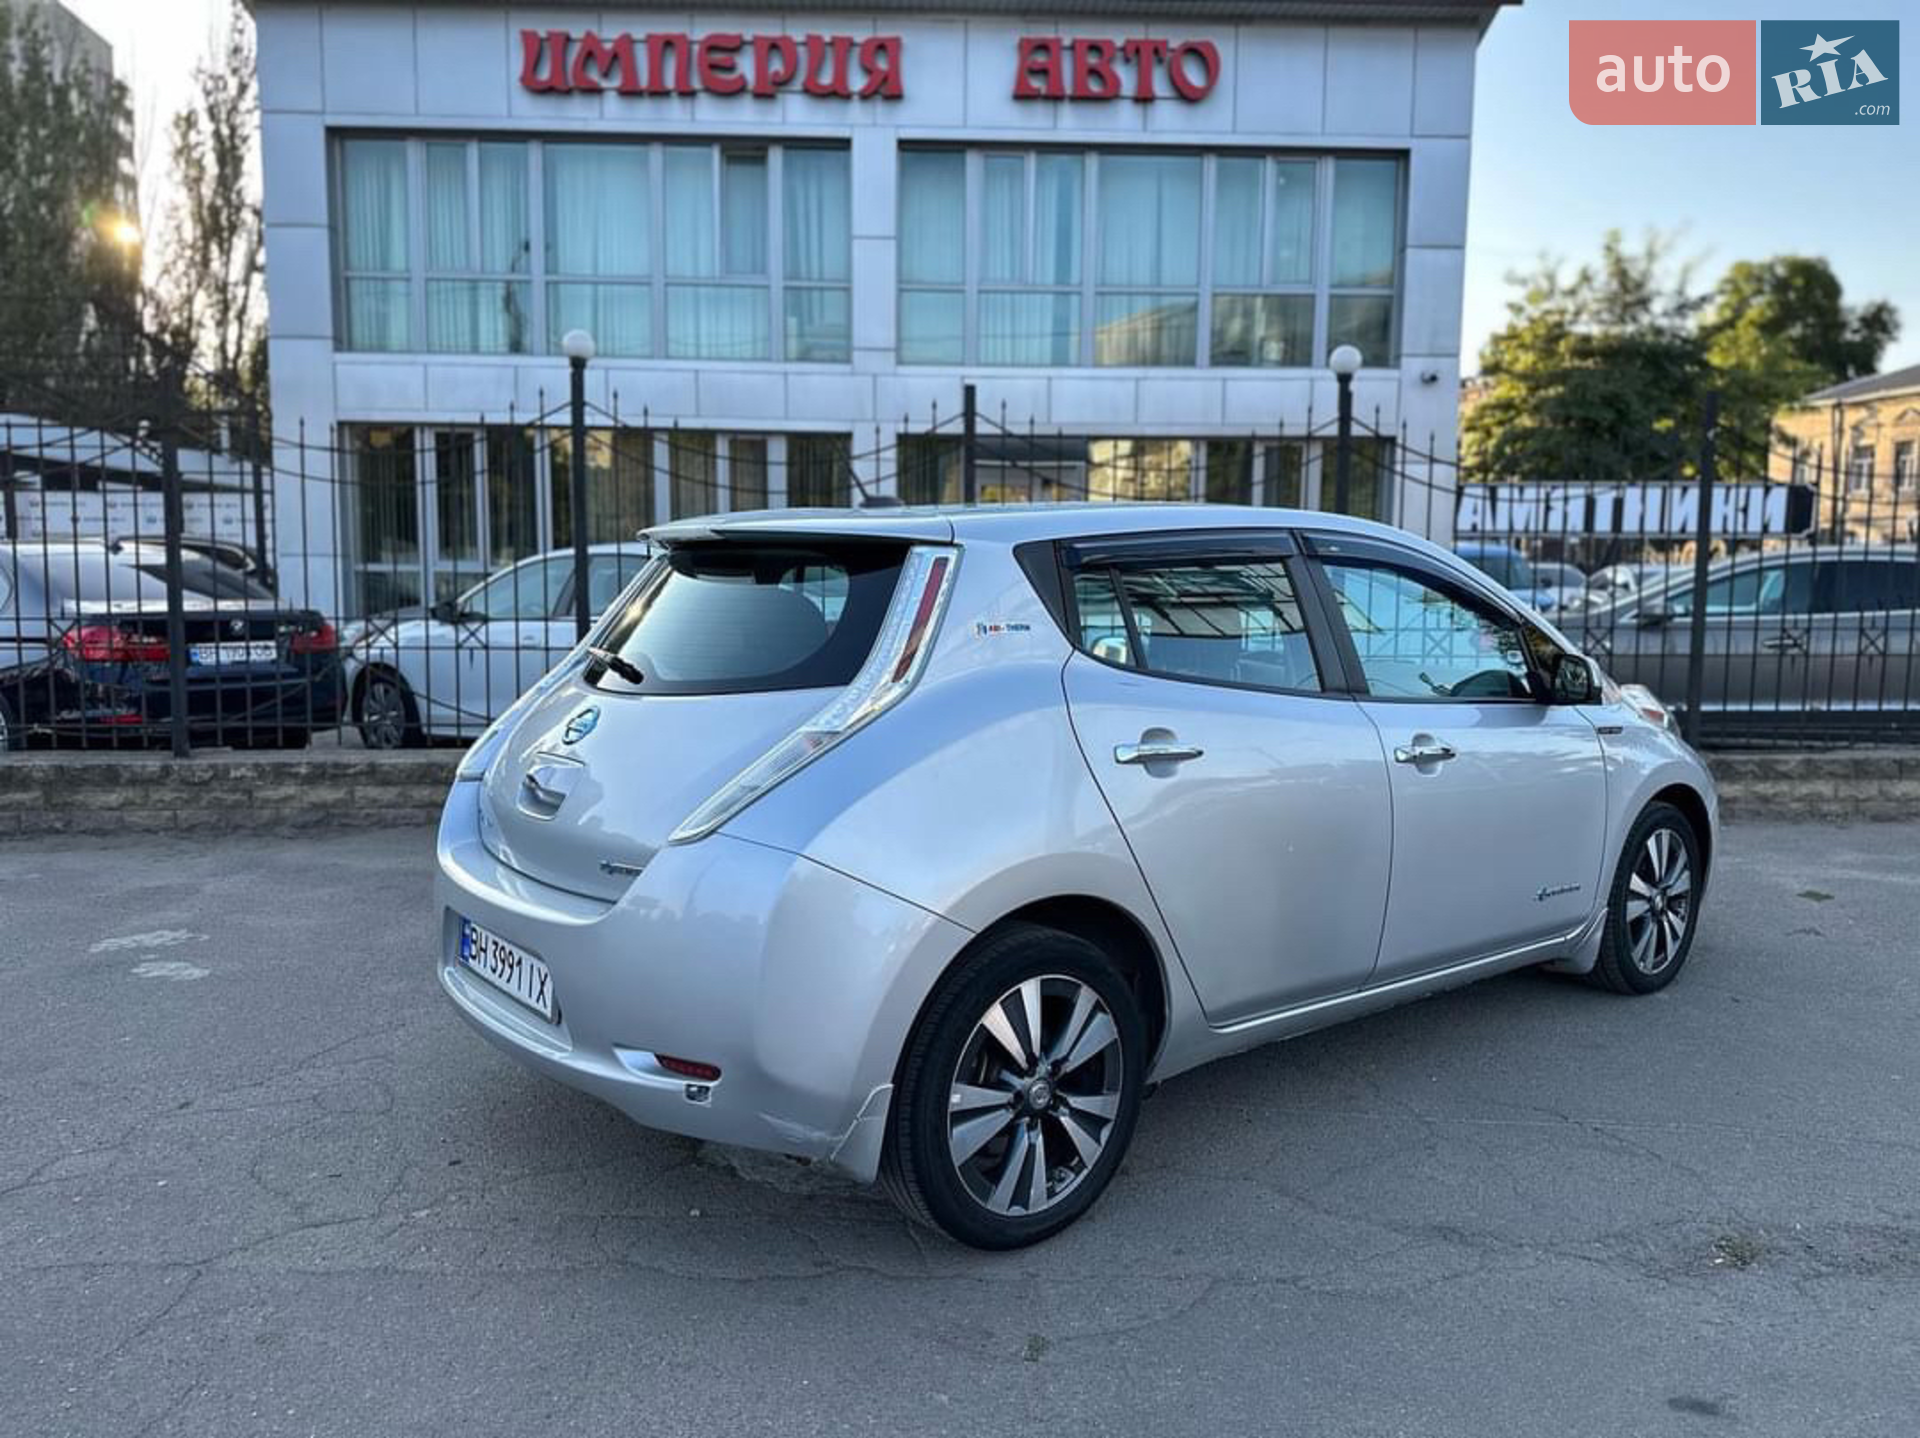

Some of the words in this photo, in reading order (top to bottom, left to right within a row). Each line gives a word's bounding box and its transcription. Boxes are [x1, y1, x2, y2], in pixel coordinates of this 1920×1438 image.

[520, 30, 903, 98] ИМПЕРИЯ
[1013, 36, 1221, 101] АВТО
[490, 940, 523, 992] 3991
[528, 963, 549, 1010] IX
